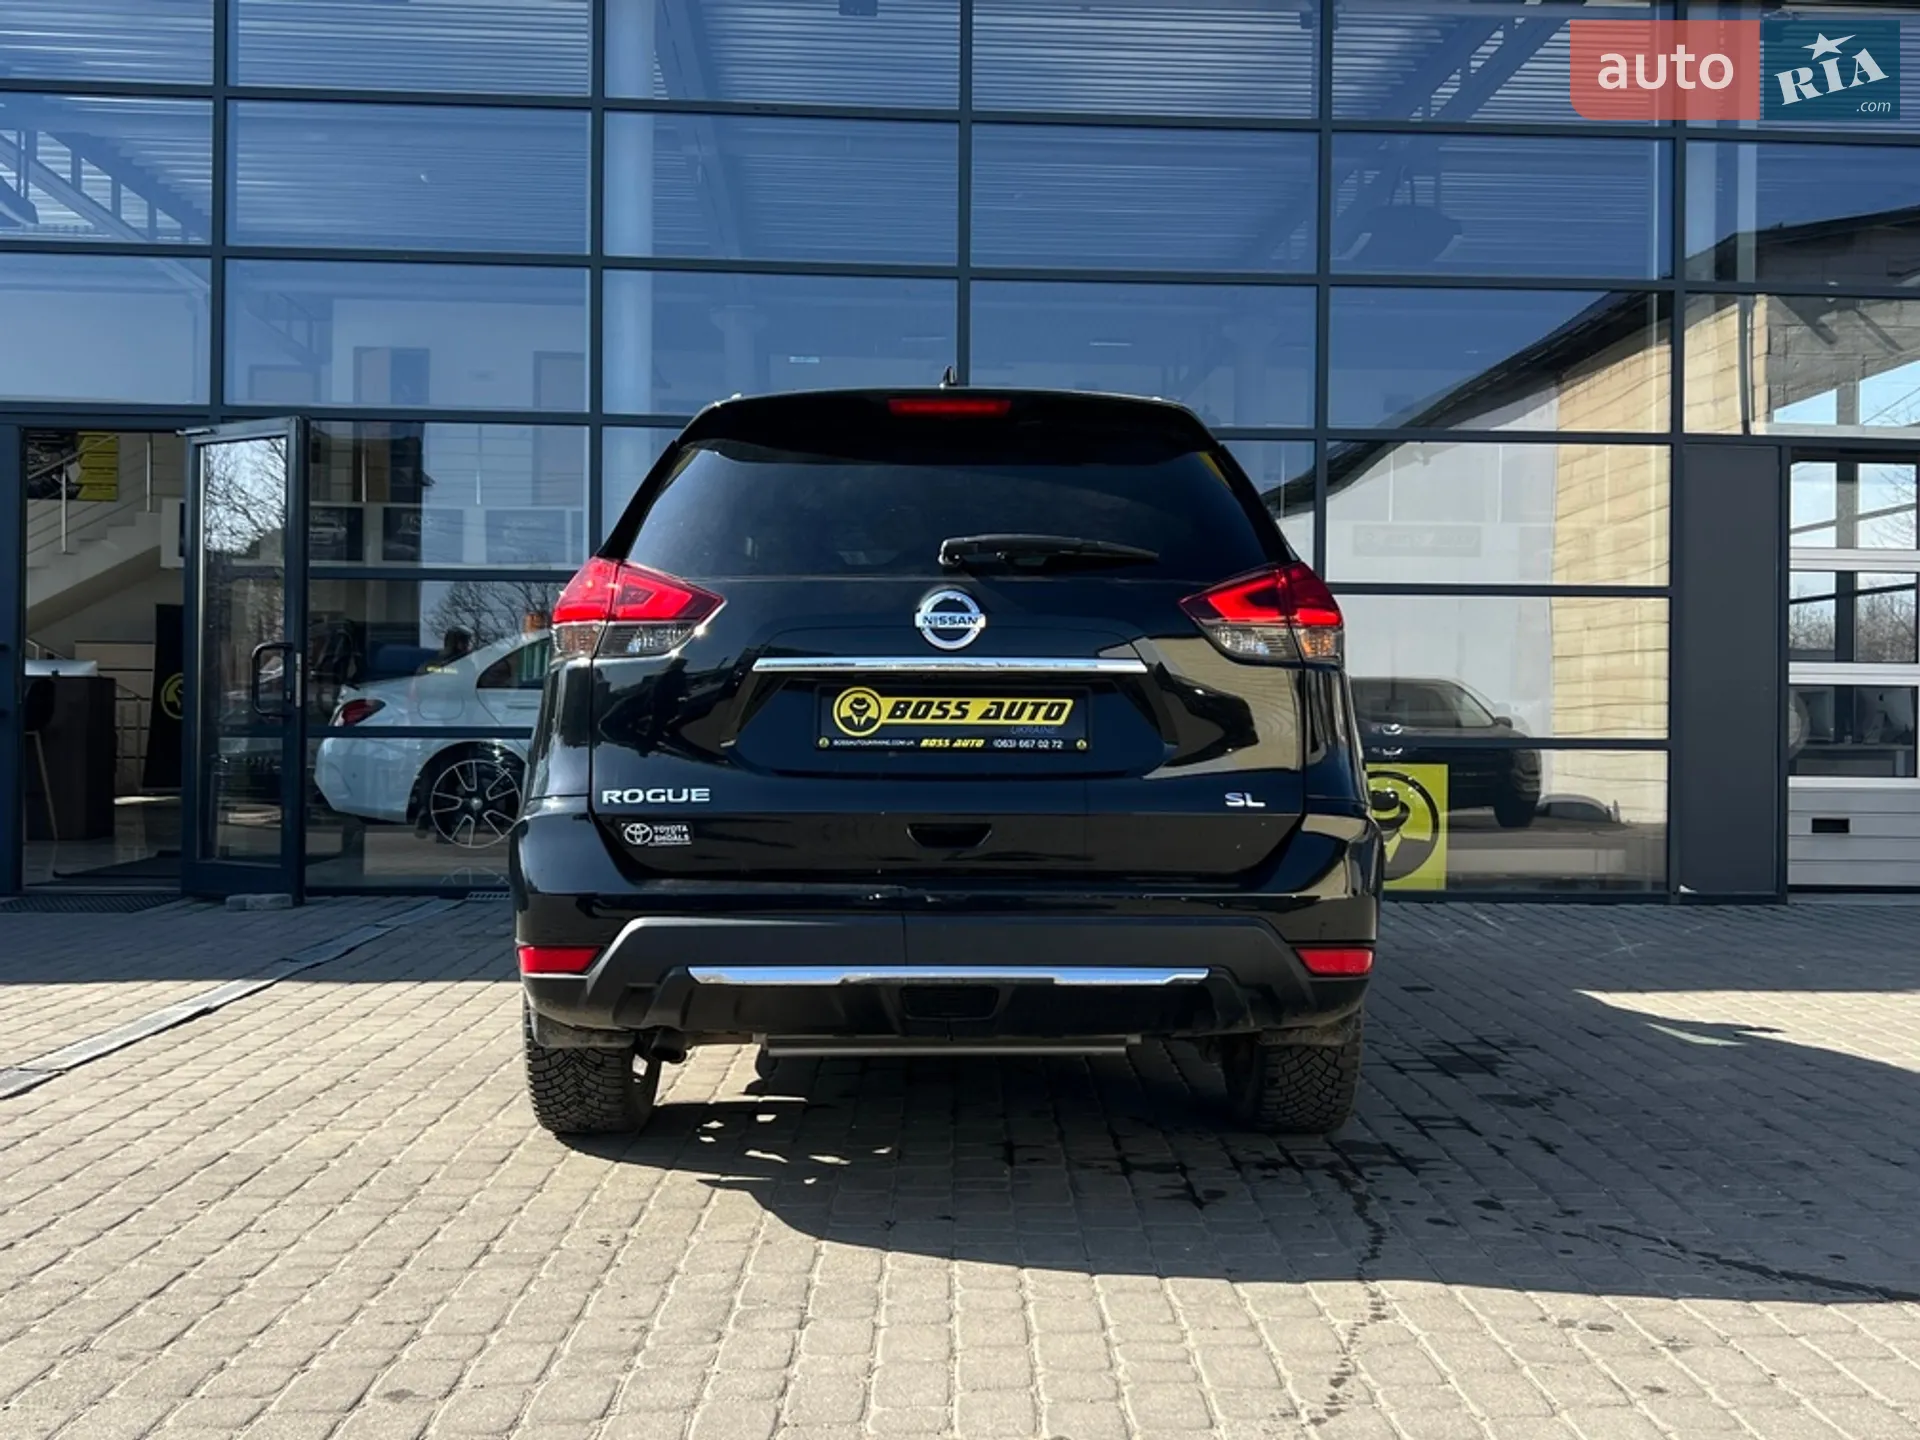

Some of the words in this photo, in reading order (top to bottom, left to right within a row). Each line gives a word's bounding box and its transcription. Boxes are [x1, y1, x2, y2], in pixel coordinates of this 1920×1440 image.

[922, 615, 980, 626] NISSAN
[886, 700, 971, 720] BOSS
[976, 701, 1070, 721] AUTO
[920, 738, 950, 748] BOSS
[951, 738, 985, 748] AUTO
[1051, 740, 1064, 750] 72
[602, 788, 711, 804] ROGUE
[1225, 792, 1266, 807] SL
[652, 824, 689, 835] TOYOTA
